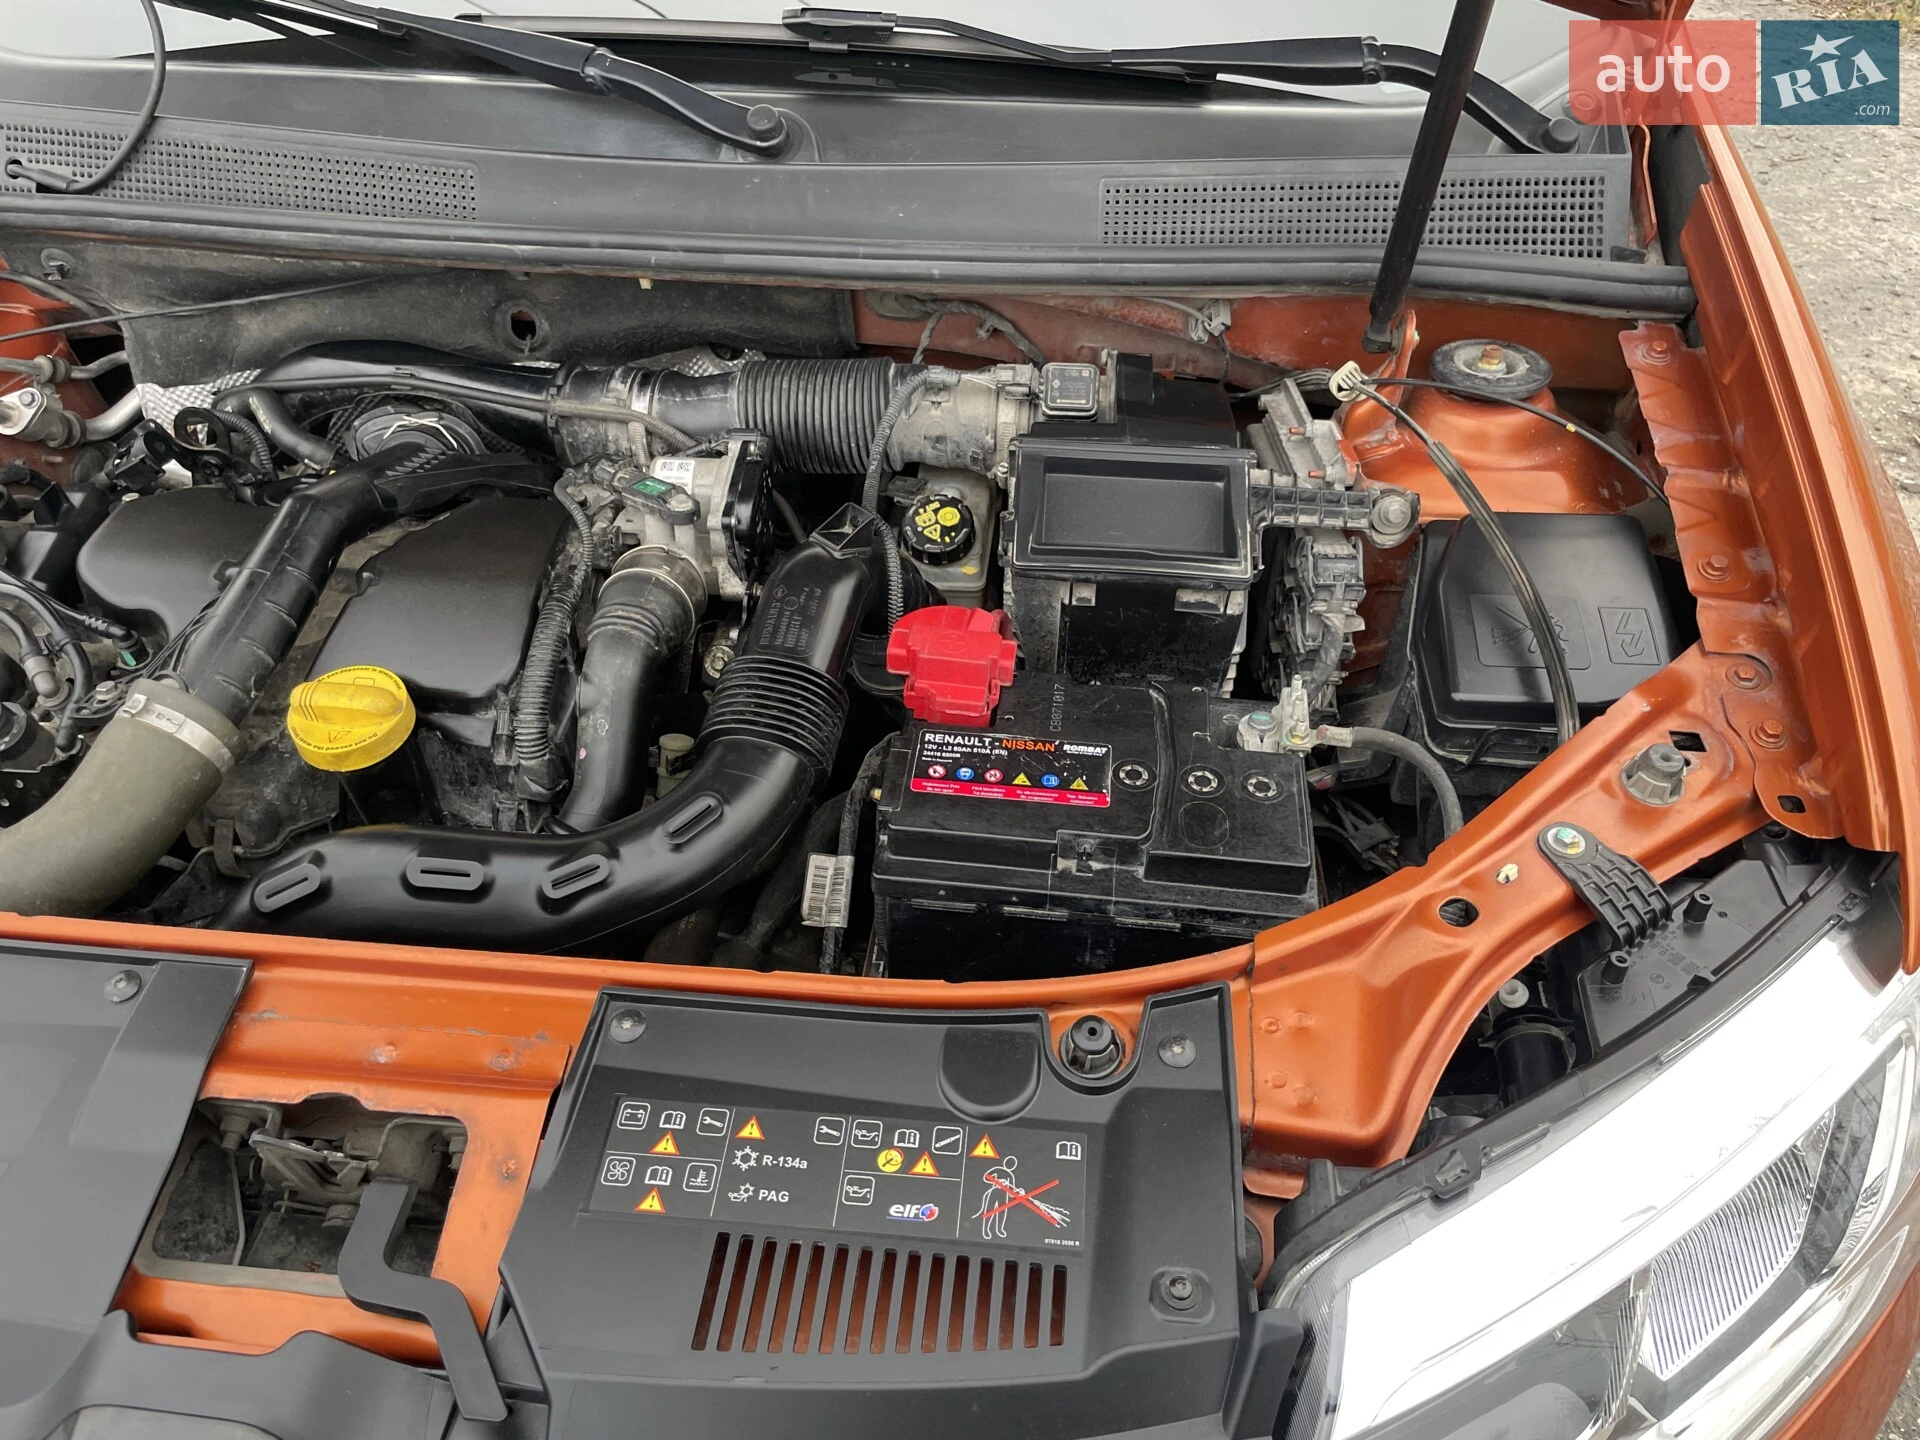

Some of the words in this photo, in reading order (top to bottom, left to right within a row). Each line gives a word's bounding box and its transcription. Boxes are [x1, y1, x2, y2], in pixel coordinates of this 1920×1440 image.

[924, 733, 992, 747] RENAULT
[1002, 739, 1055, 752] NISSAN
[762, 1155, 808, 1169] R-134a
[758, 1190, 790, 1203] PAG
[888, 1203, 921, 1218] elf
